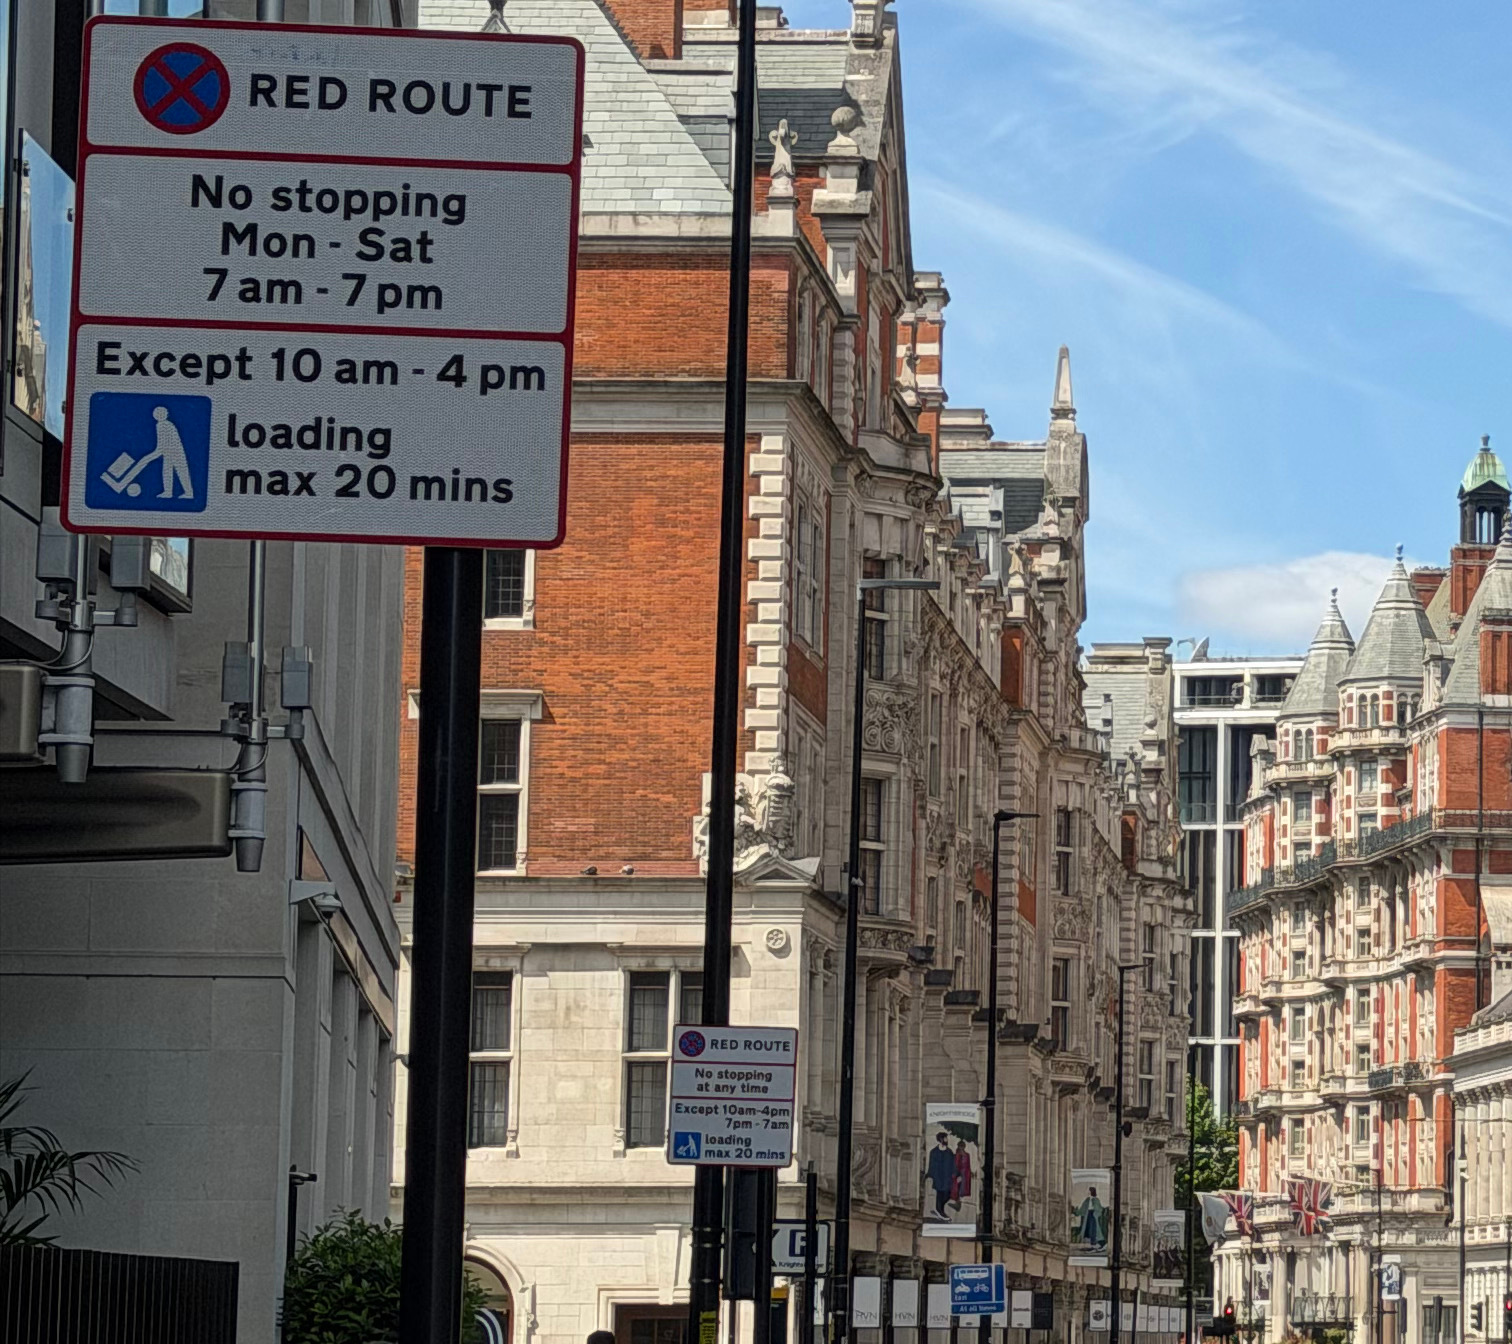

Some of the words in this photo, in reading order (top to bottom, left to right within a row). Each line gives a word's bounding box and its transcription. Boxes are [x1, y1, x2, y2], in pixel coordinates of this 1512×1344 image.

[248, 72, 348, 111] RED
[368, 78, 533, 120] ROUTE
[190, 173, 253, 211] No
[269, 178, 467, 227] stopping
[220, 221, 316, 259] Mon
[354, 226, 434, 265] Sat
[95, 340, 254, 386] Except
[226, 412, 392, 460] loading
[223, 467, 318, 498] max
[333, 463, 397, 500] 20
[409, 467, 514, 504] mins
[710, 1039, 739, 1050] RED
[743, 1040, 791, 1052] ROUTE
[695, 1068, 713, 1079] No
[717, 1069, 772, 1082] stopping
[697, 1082, 710, 1093] at
[714, 1085, 736, 1094] any
[741, 1083, 769, 1094] time
[675, 1103, 719, 1116] Except
[704, 1149, 731, 1158] max
[735, 1148, 753, 1158] 20
[755, 1150, 785, 1159] mins
[705, 1134, 752, 1147] loading
